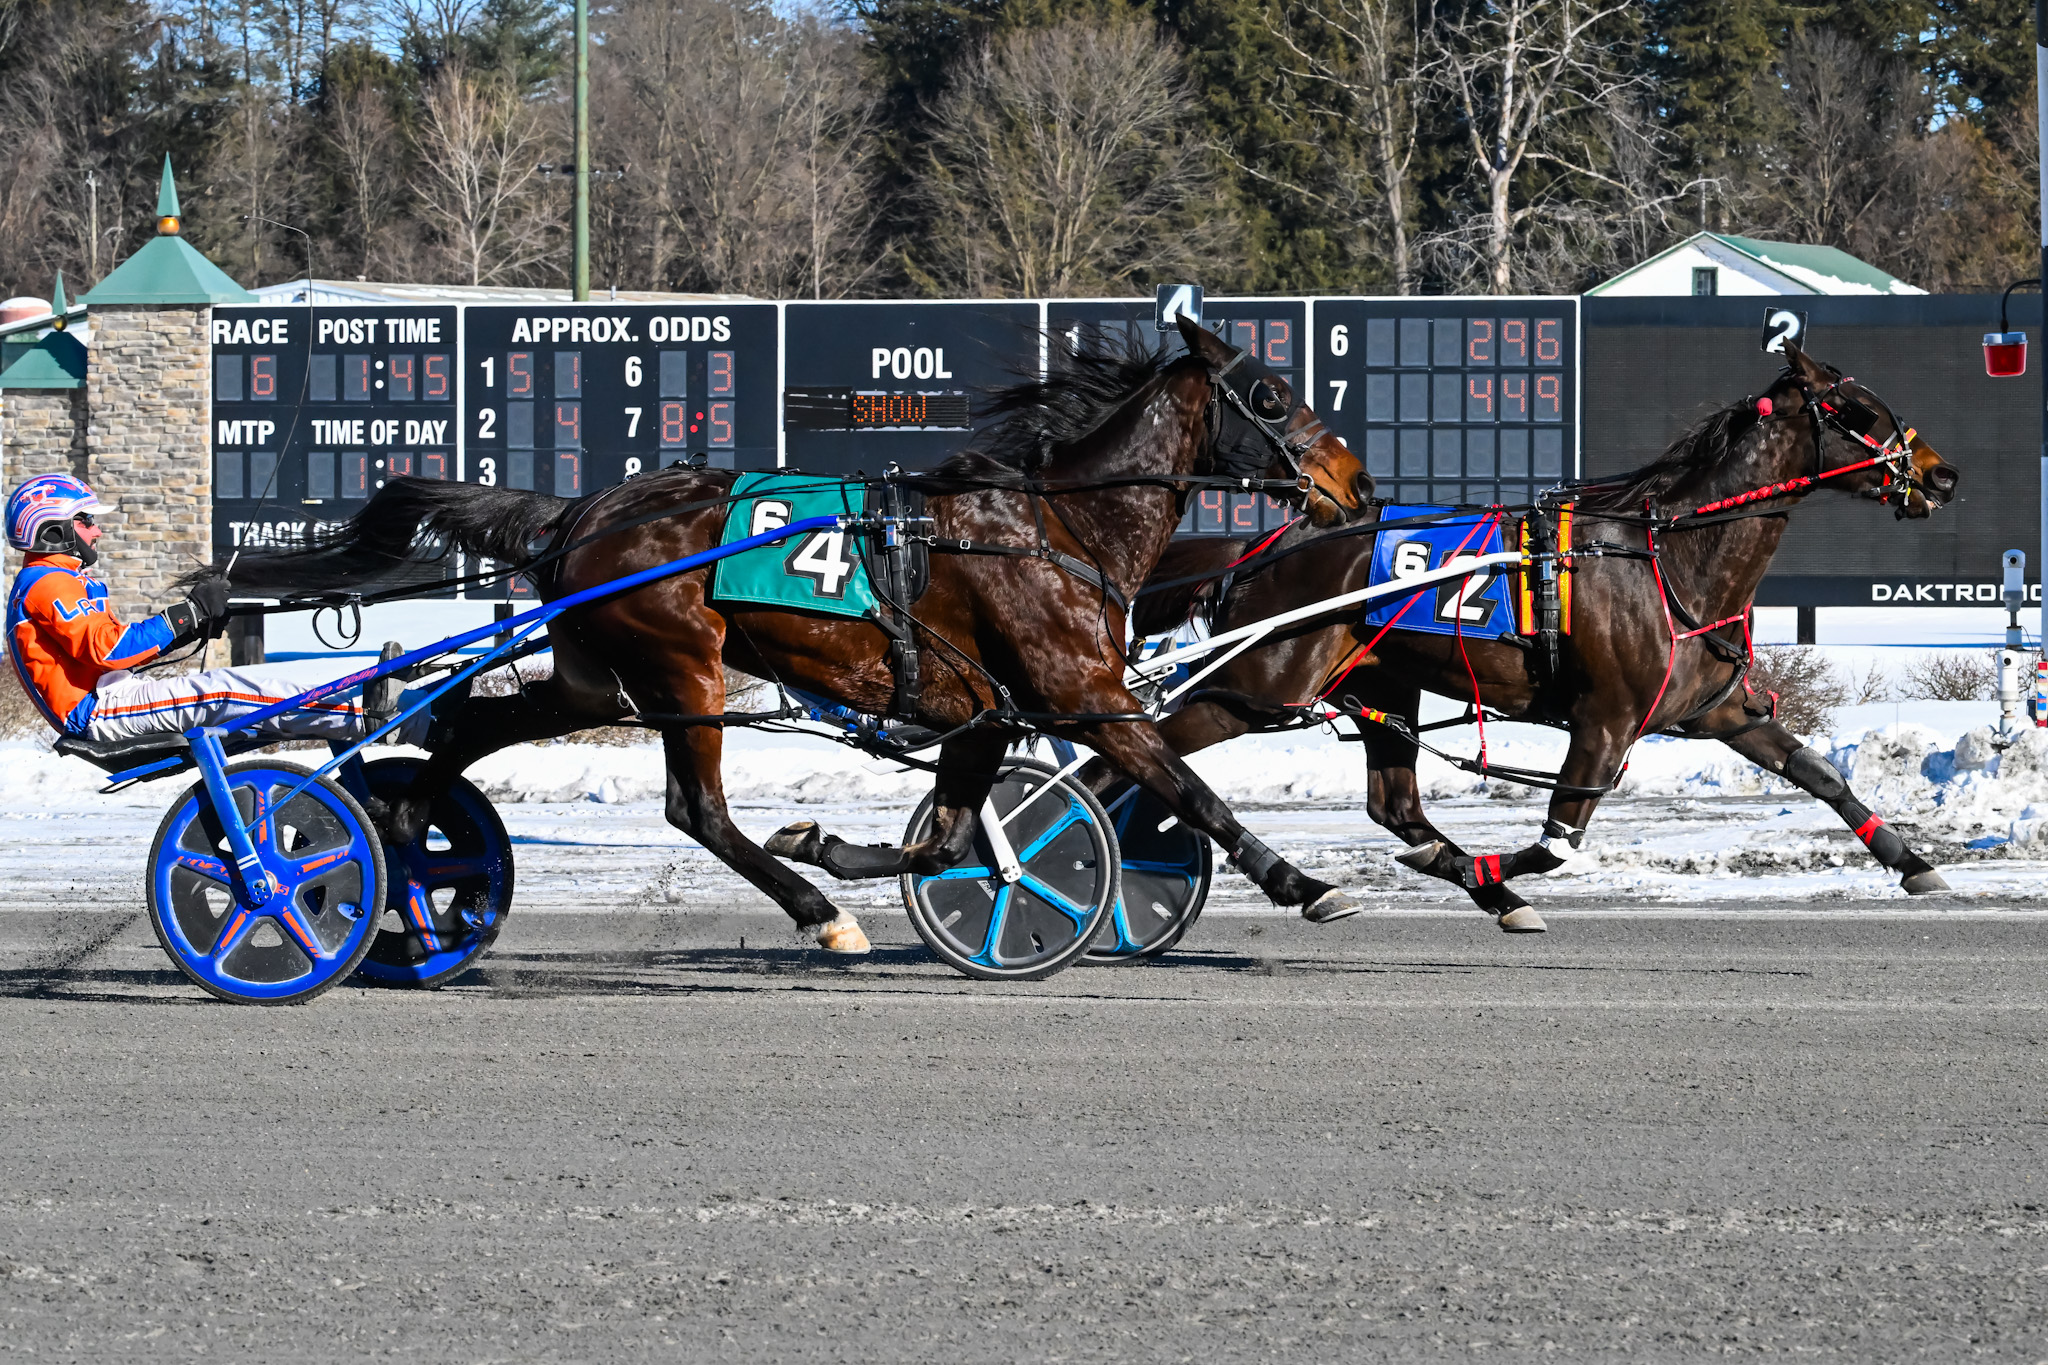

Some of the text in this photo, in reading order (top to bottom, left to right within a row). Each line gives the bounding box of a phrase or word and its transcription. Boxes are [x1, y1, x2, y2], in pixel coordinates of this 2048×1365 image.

[1163, 285, 1199, 323] 4
[212, 319, 288, 344] RACE
[318, 318, 441, 344] POST TIME
[511, 316, 731, 342] APPROX. ODDS
[1237, 322, 1289, 361] 72
[1330, 324, 1349, 356] 6
[1469, 320, 1559, 360] 296
[1766, 310, 1800, 353] 2
[253, 357, 274, 395] 6
[362, 357, 447, 395] 1:45
[480, 357, 494, 388] 1
[624, 356, 642, 387] 6
[713, 353, 732, 392] 3
[872, 347, 952, 379] POOL
[853, 395, 926, 422] SHOW
[1329, 380, 1348, 411] 7
[1469, 376, 1559, 413] 449
[218, 420, 275, 444] MTP
[311, 420, 448, 444] TIME OF DAY
[478, 408, 496, 439] 2
[557, 406, 578, 440] 4
[624, 407, 642, 437] 7
[360, 455, 444, 490] 1:47
[478, 457, 496, 487] 3
[560, 454, 578, 489] 7
[229, 522, 306, 547] TRACK
[752, 502, 788, 544] 6
[792, 520, 850, 594] 4
[1395, 543, 1428, 579] 6
[1441, 555, 1490, 621] 2
